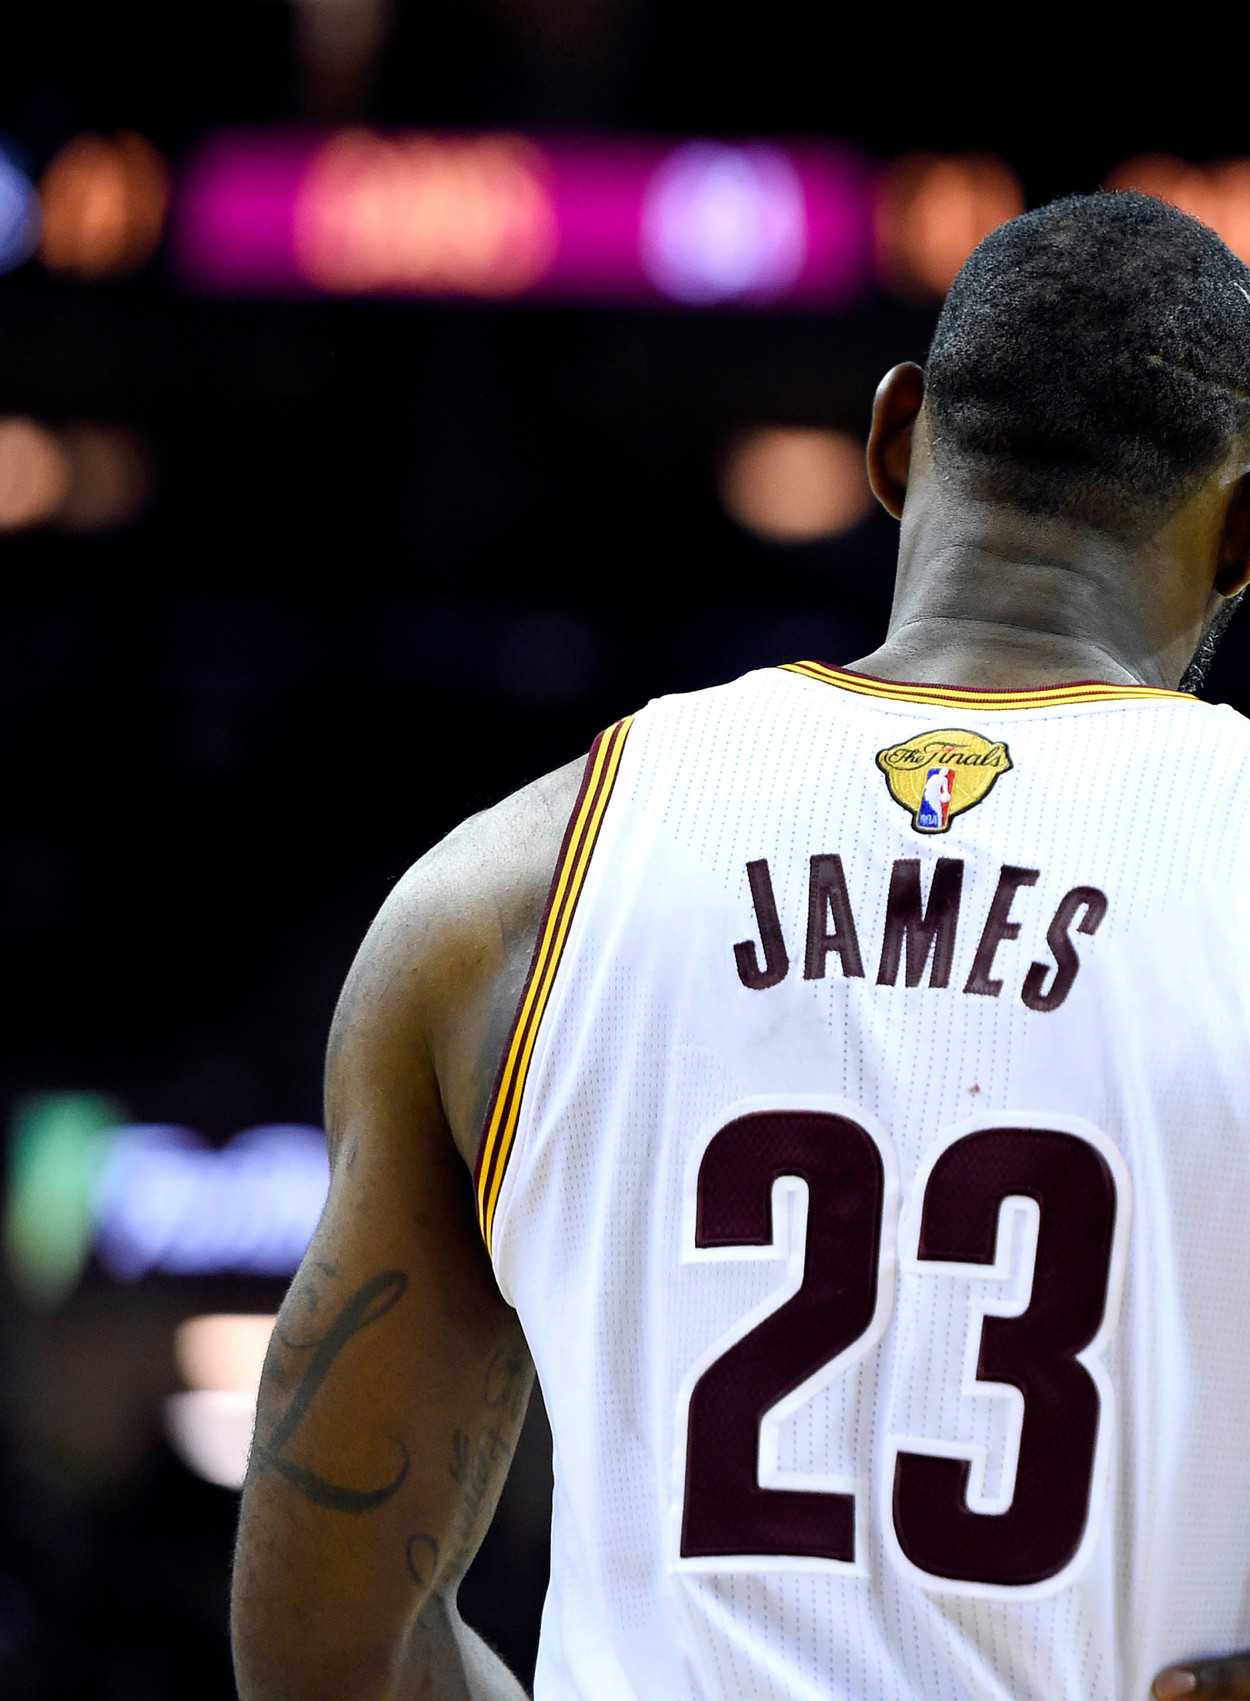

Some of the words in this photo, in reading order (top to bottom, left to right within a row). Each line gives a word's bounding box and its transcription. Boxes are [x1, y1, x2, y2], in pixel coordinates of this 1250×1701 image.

[885, 748, 924, 769] The
[922, 741, 1003, 768] Finals
[732, 853, 1109, 1013] JAMES
[679, 1109, 1118, 1587] 23
